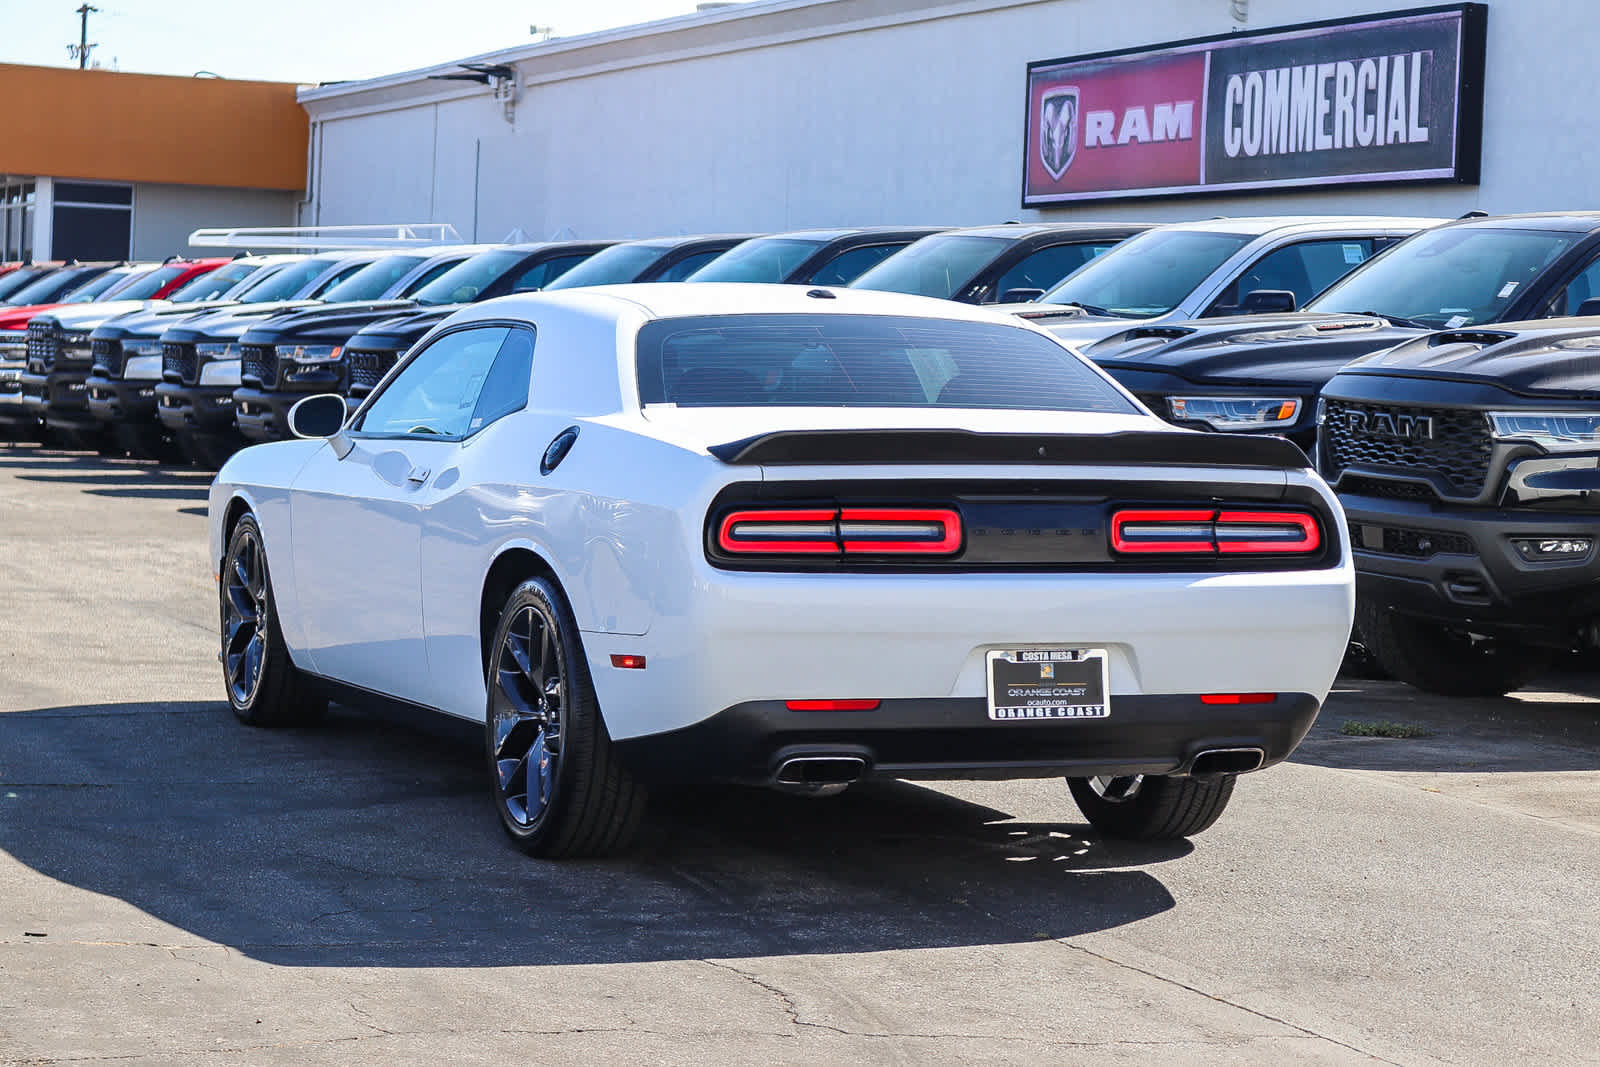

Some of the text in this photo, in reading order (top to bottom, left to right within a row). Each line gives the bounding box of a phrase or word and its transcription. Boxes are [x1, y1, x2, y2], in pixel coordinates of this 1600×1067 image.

[1223, 51, 1430, 158] COMMERCIAL
[1084, 100, 1194, 148] RAM
[1344, 409, 1433, 439] RAM
[1022, 651, 1073, 661] COSTA MESA
[1007, 687, 1087, 697] ORANGE COAST
[1027, 698, 1068, 706] ocauto.com
[997, 706, 1102, 718] ORANGE COAST
